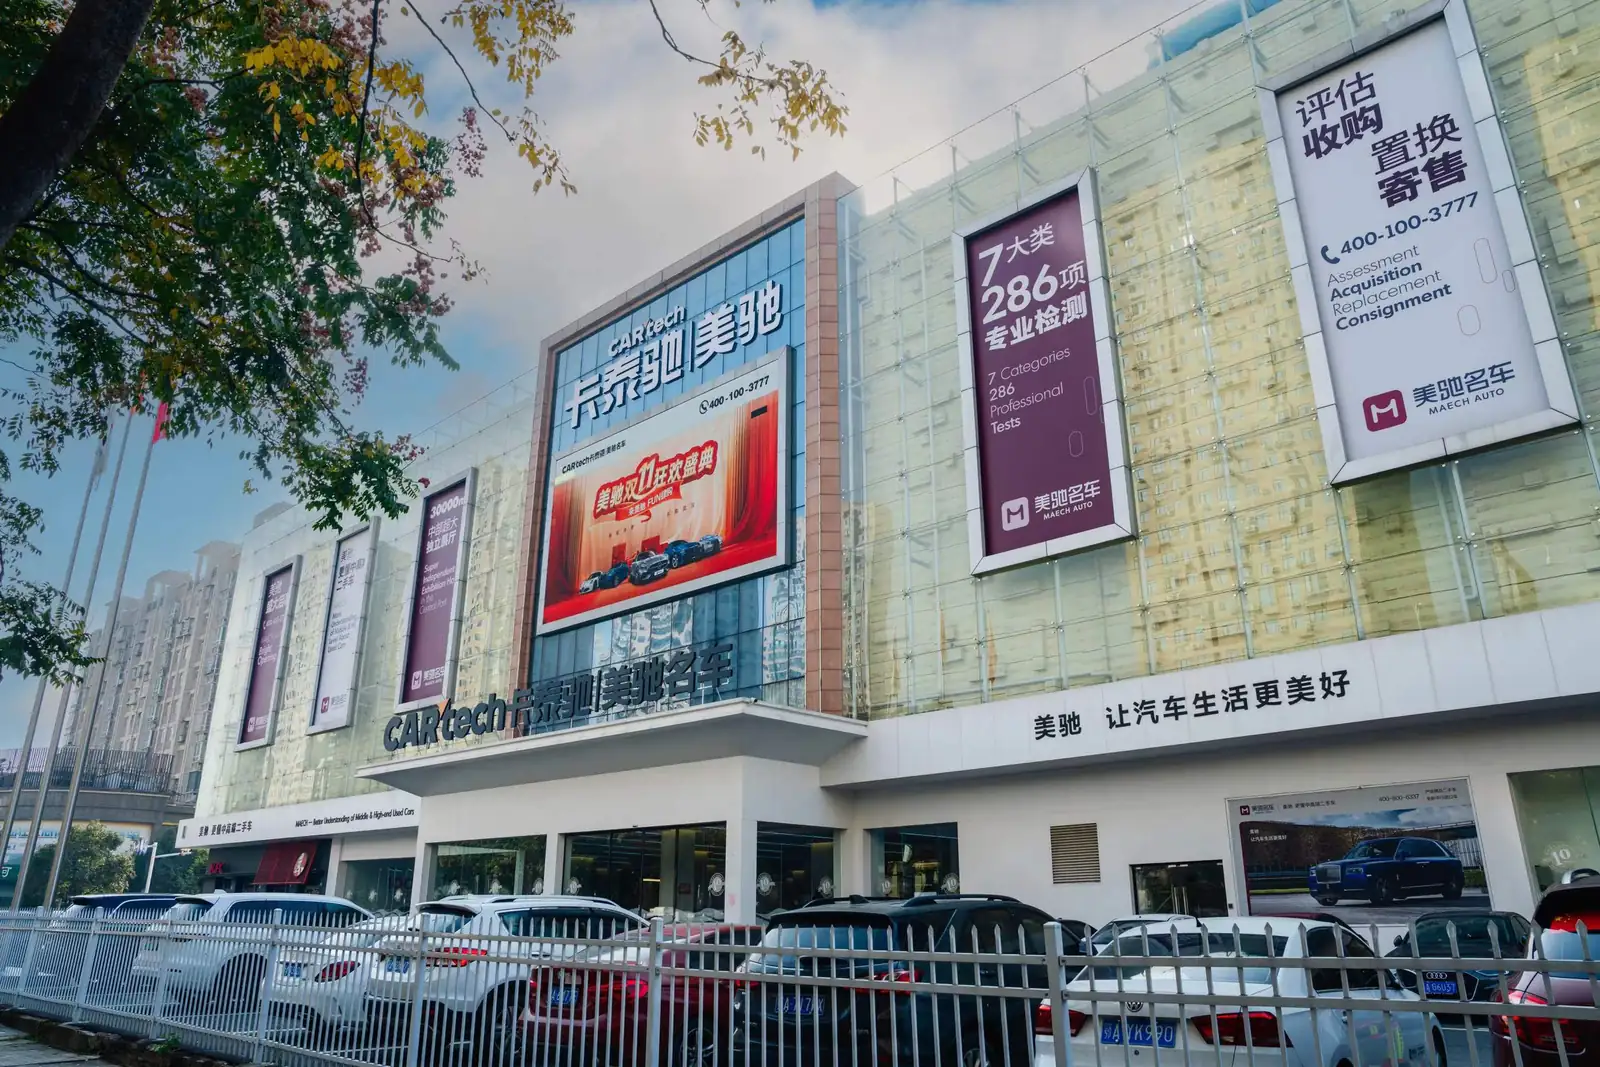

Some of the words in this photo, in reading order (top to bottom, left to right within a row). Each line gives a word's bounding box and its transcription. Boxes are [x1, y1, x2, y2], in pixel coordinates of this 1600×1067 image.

[1296, 71, 1376, 127] 评估
[1302, 103, 1384, 160] 收购
[1371, 113, 1462, 175] 置换
[1377, 149, 1468, 208] 寄售
[1340, 191, 1479, 255] 400-100-3777
[978, 222, 1055, 287] 7大类
[1327, 245, 1420, 287] Assessment
[981, 260, 1086, 325] 286项
[1330, 261, 1423, 302] Acquisition
[1333, 270, 1442, 317] Replacement
[608, 305, 686, 357] CARtech
[984, 291, 1088, 351] 专业检测
[1336, 283, 1452, 331] Consignment
[988, 372, 997, 386] 7
[1000, 347, 1071, 380] Categories
[1412, 360, 1516, 408] 美驰名车
[708, 375, 770, 410] 400-100-3777
[989, 382, 1015, 402] 286
[990, 381, 1064, 418] Professional
[1429, 397, 1470, 416] MAECH
[1475, 387, 1505, 402] AUTO
[991, 416, 1021, 435] Tests
[1034, 479, 1101, 514] 美驰名车
[1043, 507, 1071, 521] MAECH
[1073, 501, 1094, 513] AUTO
[1033, 710, 1082, 741] 美驰
[1105, 669, 1351, 731] 让汽车生活更美好
